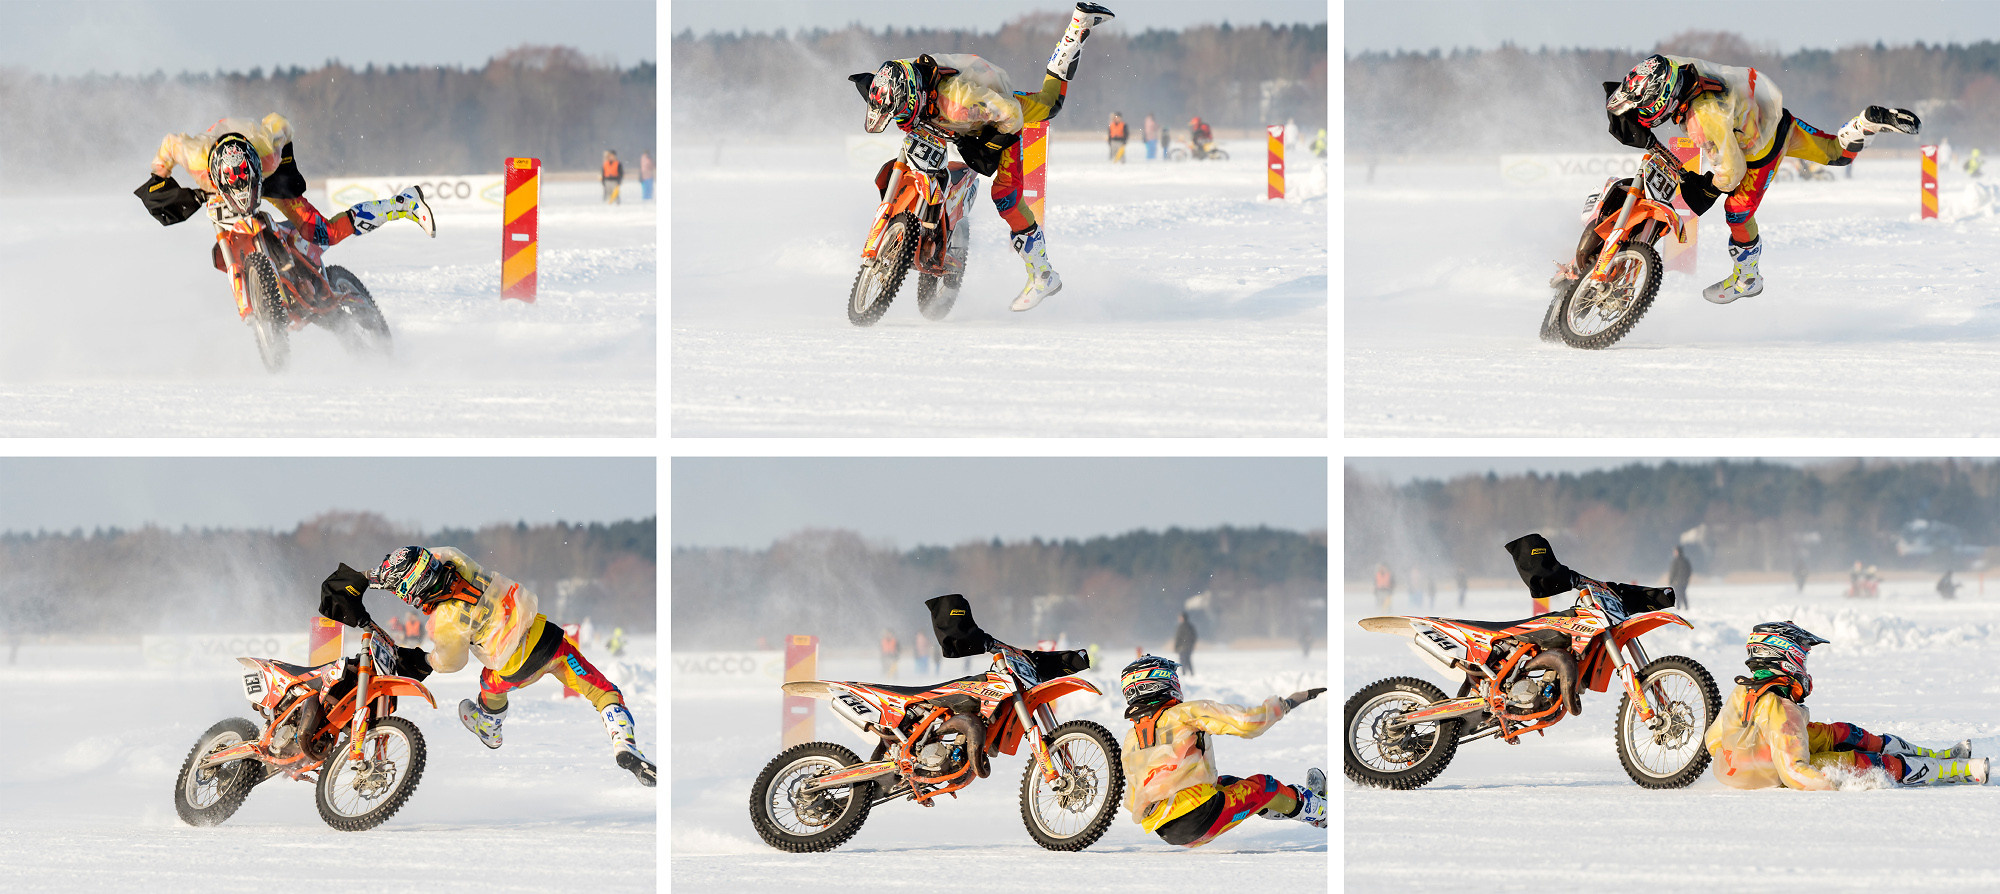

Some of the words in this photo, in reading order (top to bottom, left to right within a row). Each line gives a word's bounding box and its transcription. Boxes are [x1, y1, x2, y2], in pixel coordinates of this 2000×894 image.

[908, 139, 942, 168] 139
[1556, 158, 1637, 175] YACCO
[387, 182, 471, 199] YCCO
[1647, 166, 1675, 200] 139
[1422, 630, 1458, 650] 139
[1766, 636, 1793, 649] FOX
[675, 656, 757, 674] YACCO
[1152, 670, 1172, 678] FOX
[244, 673, 261, 695] 139
[981, 688, 1003, 699] TEAM
[838, 694, 871, 715] 139
